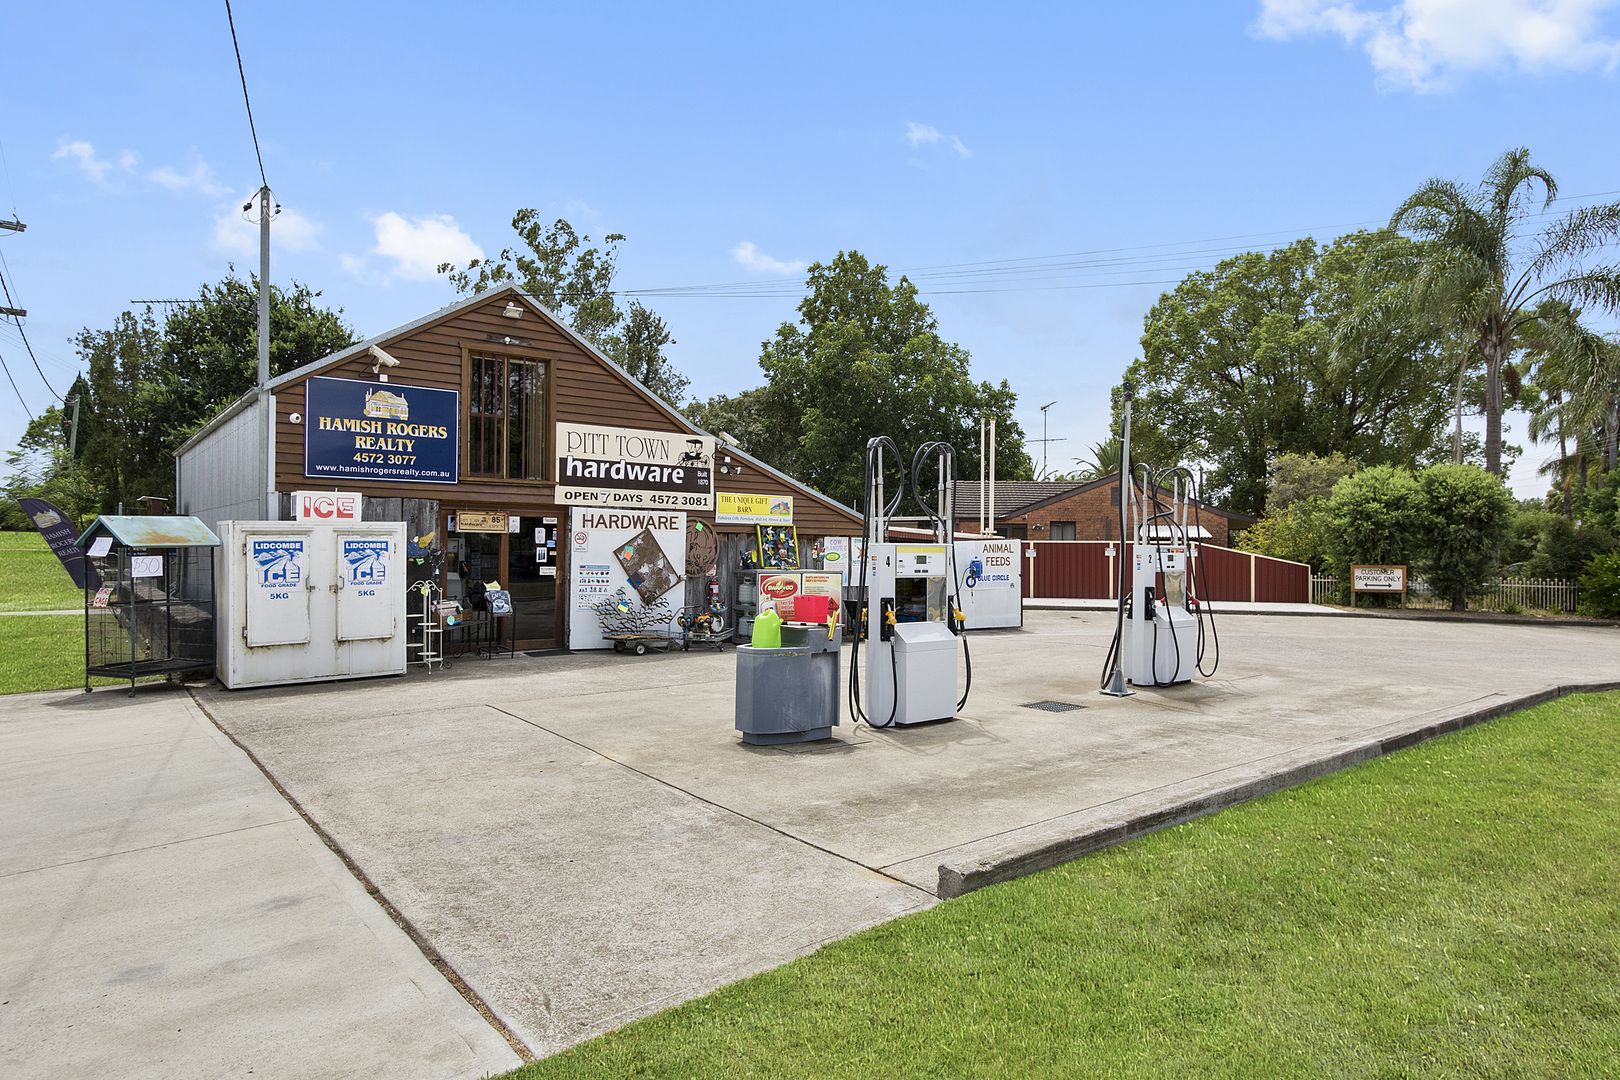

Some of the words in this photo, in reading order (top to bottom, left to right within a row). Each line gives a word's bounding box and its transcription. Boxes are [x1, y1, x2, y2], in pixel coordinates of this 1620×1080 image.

[319, 416, 382, 434] HAMISH
[386, 421, 448, 439] ROGERS
[355, 435, 415, 452] REALTY
[567, 431, 610, 455] PITT
[616, 435, 670, 461] TOWN
[353, 452, 384, 464] 4572
[388, 454, 417, 465] 3077
[315, 464, 450, 478] www.hamishrogersrealty.com.au
[566, 455, 685, 484] hardware
[564, 491, 599, 501] OPEN
[600, 491, 611, 503] 7
[613, 493, 643, 503] DAYS
[649, 494, 678, 505] 4572
[681, 496, 709, 506] 3081
[721, 495, 733, 503] THE
[755, 497, 768, 505] GIFT
[303, 496, 355, 519] ICE
[737, 505, 752, 513] BARN
[582, 513, 679, 530] HARDWARE
[255, 542, 300, 550] LIDCOMBE
[982, 543, 1014, 554] ANIMAL
[886, 556, 891, 567] 4
[985, 556, 1011, 567] FEEDS
[1360, 568, 1395, 576] CUSTOMER
[270, 592, 289, 600] 5KG
